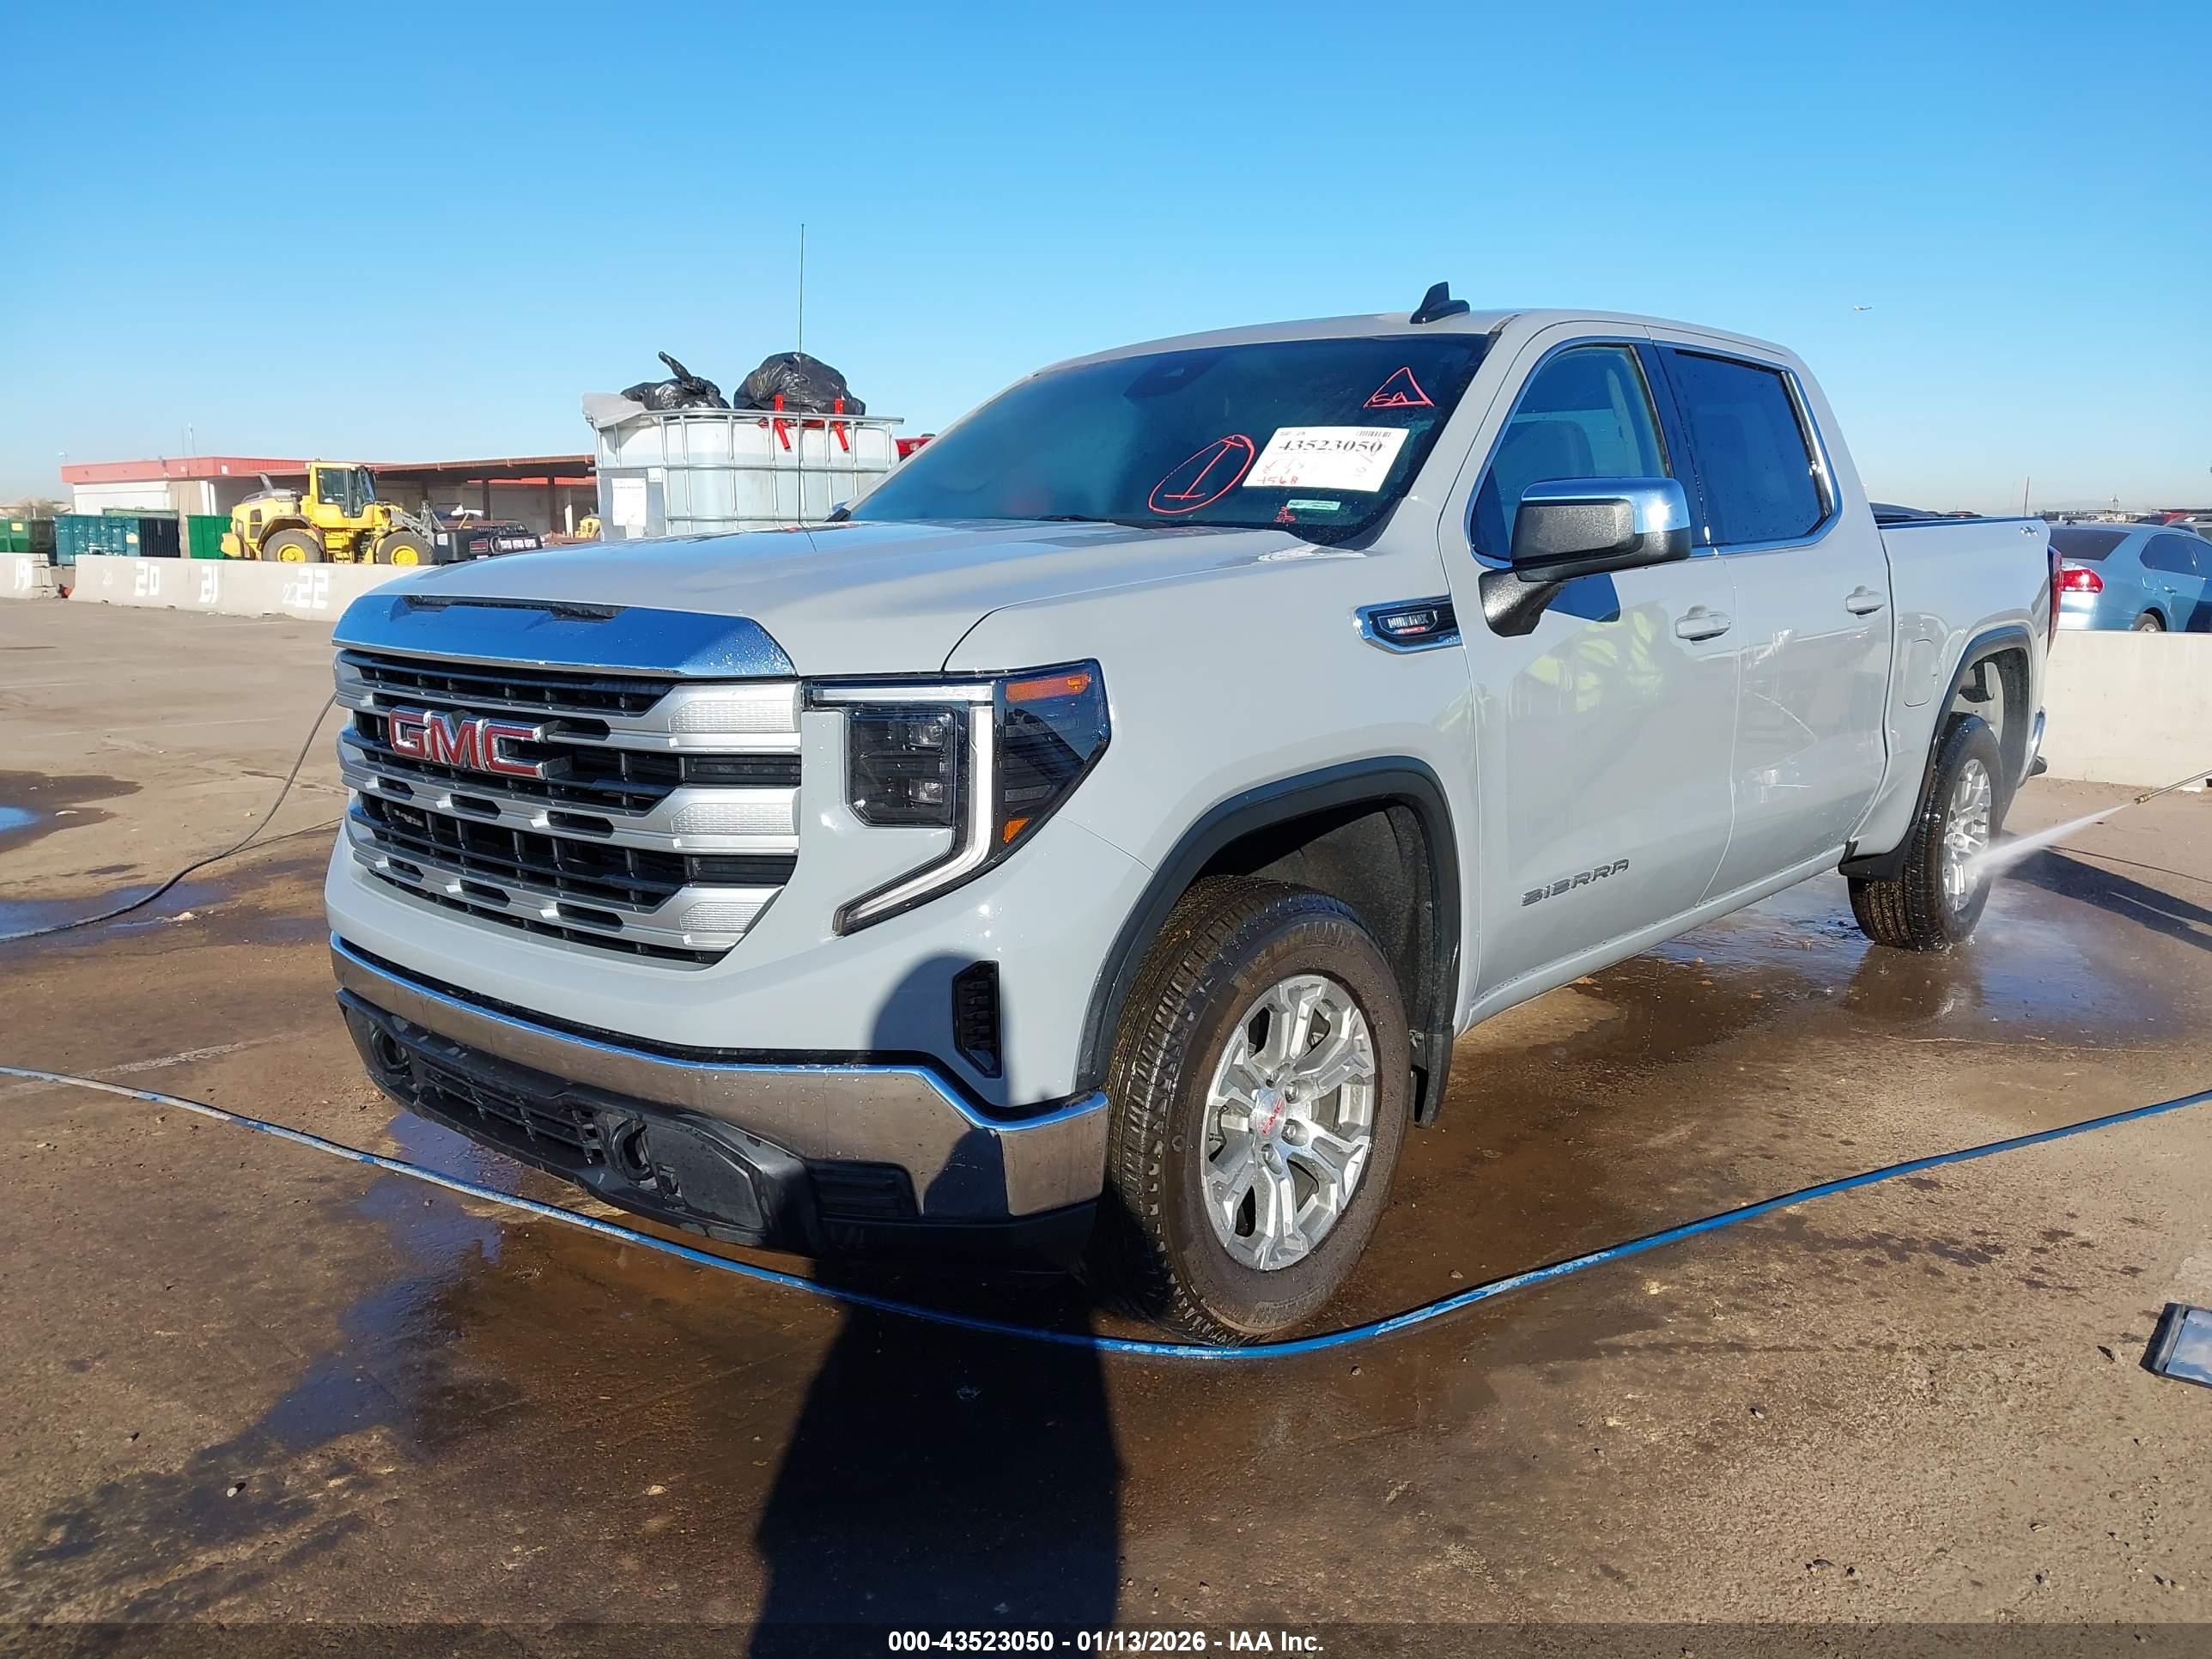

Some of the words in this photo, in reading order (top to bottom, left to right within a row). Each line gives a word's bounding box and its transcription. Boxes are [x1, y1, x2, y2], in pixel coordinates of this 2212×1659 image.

[1279, 439, 1383, 452] 43523050
[134, 561, 161, 597] 20
[295, 567, 329, 609] 22
[389, 705, 551, 781] GMC
[1521, 858, 1630, 907] SIERRA
